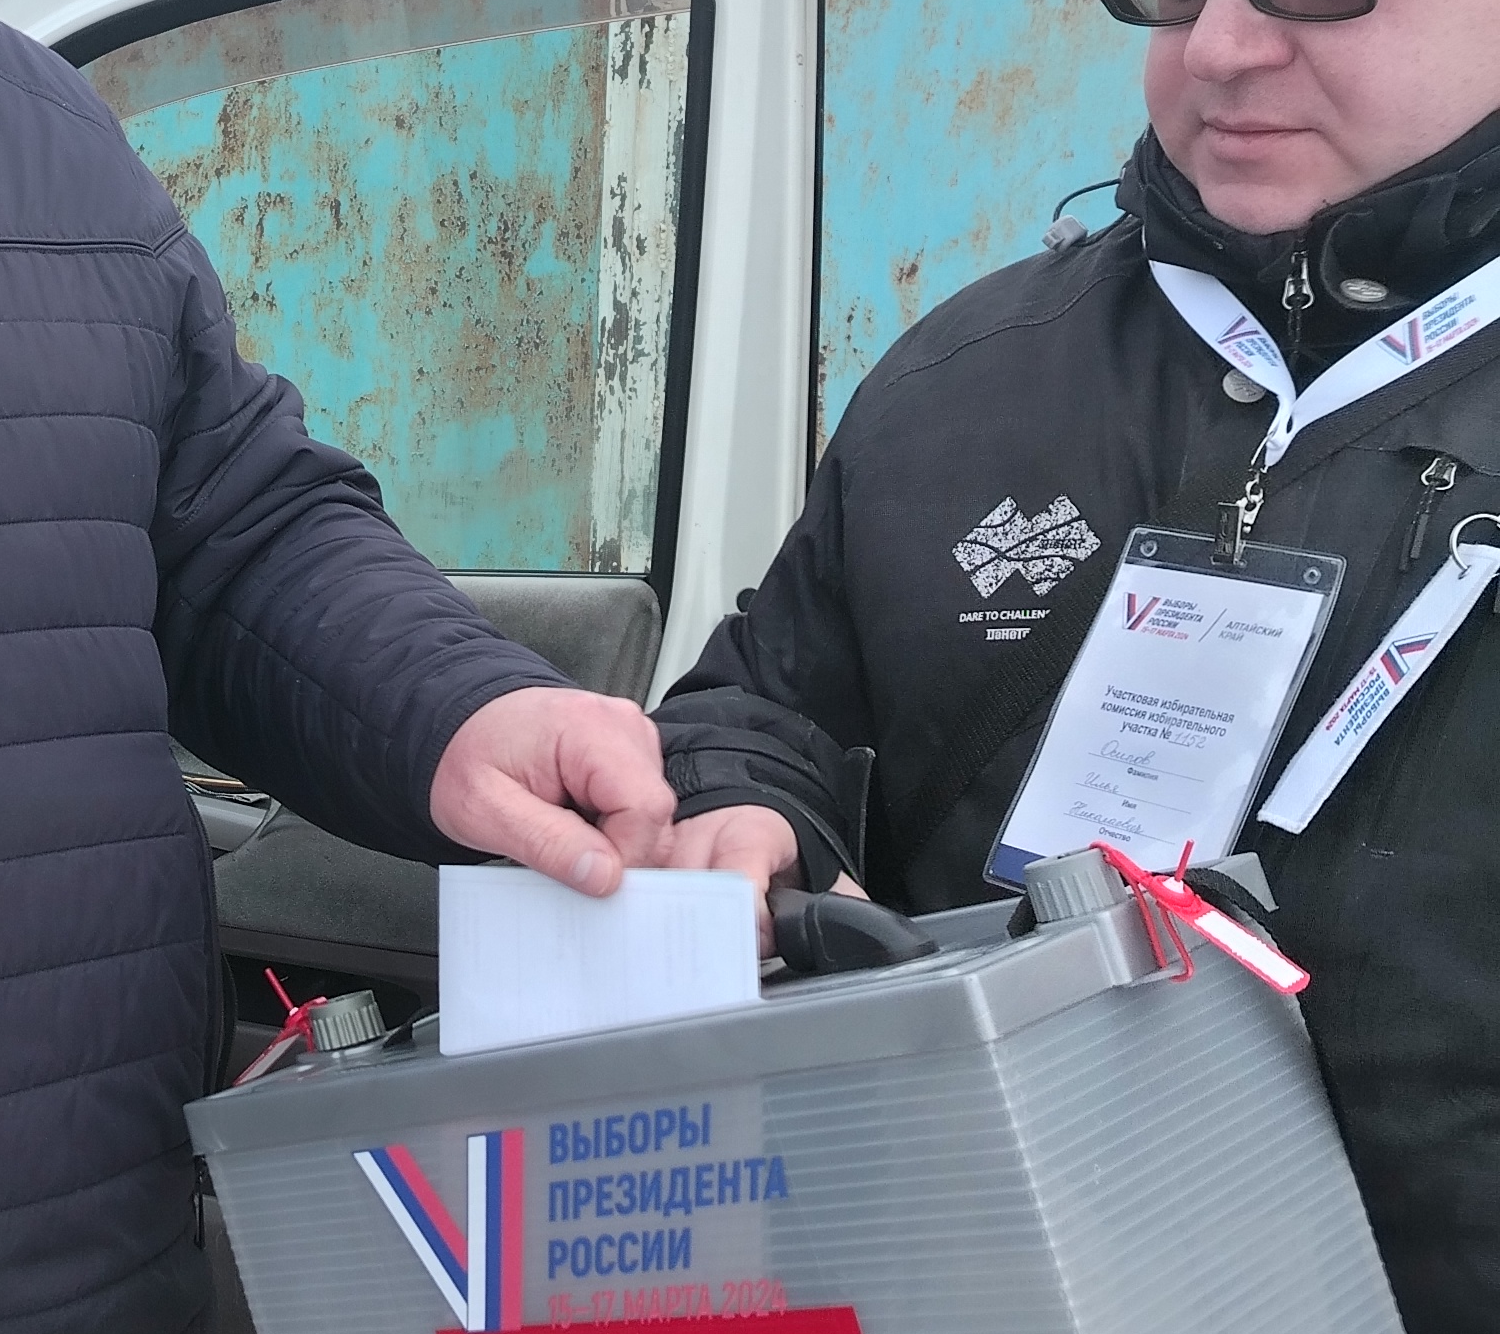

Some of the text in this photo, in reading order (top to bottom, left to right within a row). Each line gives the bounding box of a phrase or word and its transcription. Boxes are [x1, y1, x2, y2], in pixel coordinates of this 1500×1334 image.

[959, 608, 1051, 623] DARE TO CHALLEN
[1225, 620, 1284, 639] АЛТАЙСКИЙ
[1218, 629, 1244, 642] КРАЙ
[1105, 685, 1235, 724] Участковая избирательная
[1347, 673, 1381, 715] РОССИИ
[1353, 688, 1390, 736] ВЫБОРЫ
[1100, 701, 1227, 737] комиссия избирательного
[1120, 721, 1159, 738] участка
[1159, 726, 1173, 740] №
[1334, 680, 1386, 746] ПРЕЗИДЕНТА
[1127, 767, 1159, 781] Фамилия
[1121, 799, 1137, 810] Имя
[1098, 826, 1131, 843] Отчество
[548, 1103, 713, 1165] ВЫБОРЫ
[548, 1156, 790, 1223] ПРЕЗИДЕНТА
[547, 1228, 692, 1280] РОССИИ
[623, 1285, 714, 1326] МАРТА
[722, 1279, 789, 1320] 2024
